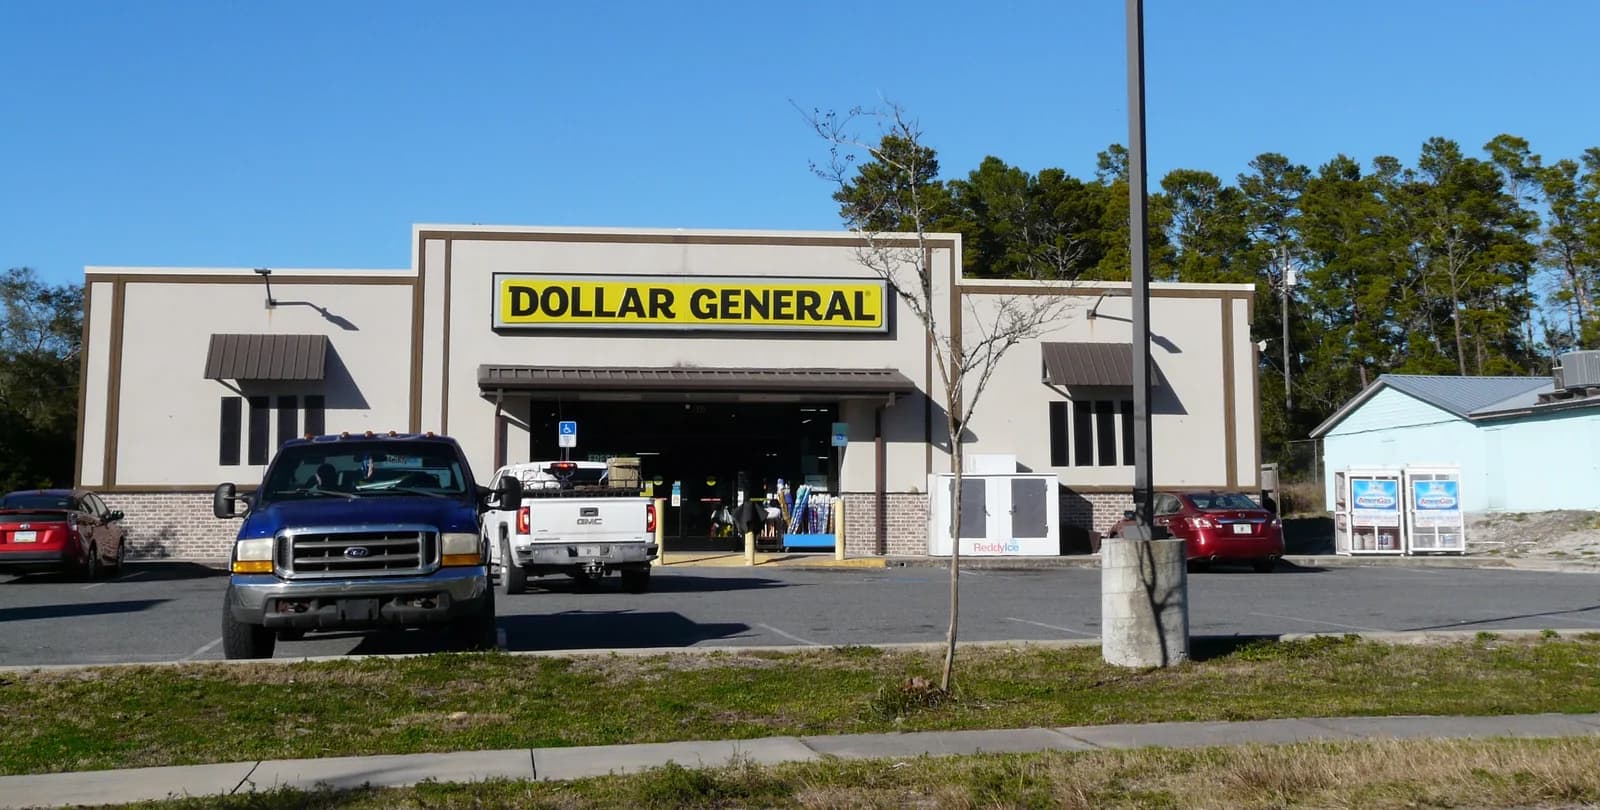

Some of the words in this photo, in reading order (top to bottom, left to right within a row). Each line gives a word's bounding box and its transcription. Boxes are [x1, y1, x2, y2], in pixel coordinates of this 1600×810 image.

[508, 285, 676, 320] DOLLAR
[689, 288, 876, 322] GENERAL
[973, 542, 1020, 553] ReddyIce
